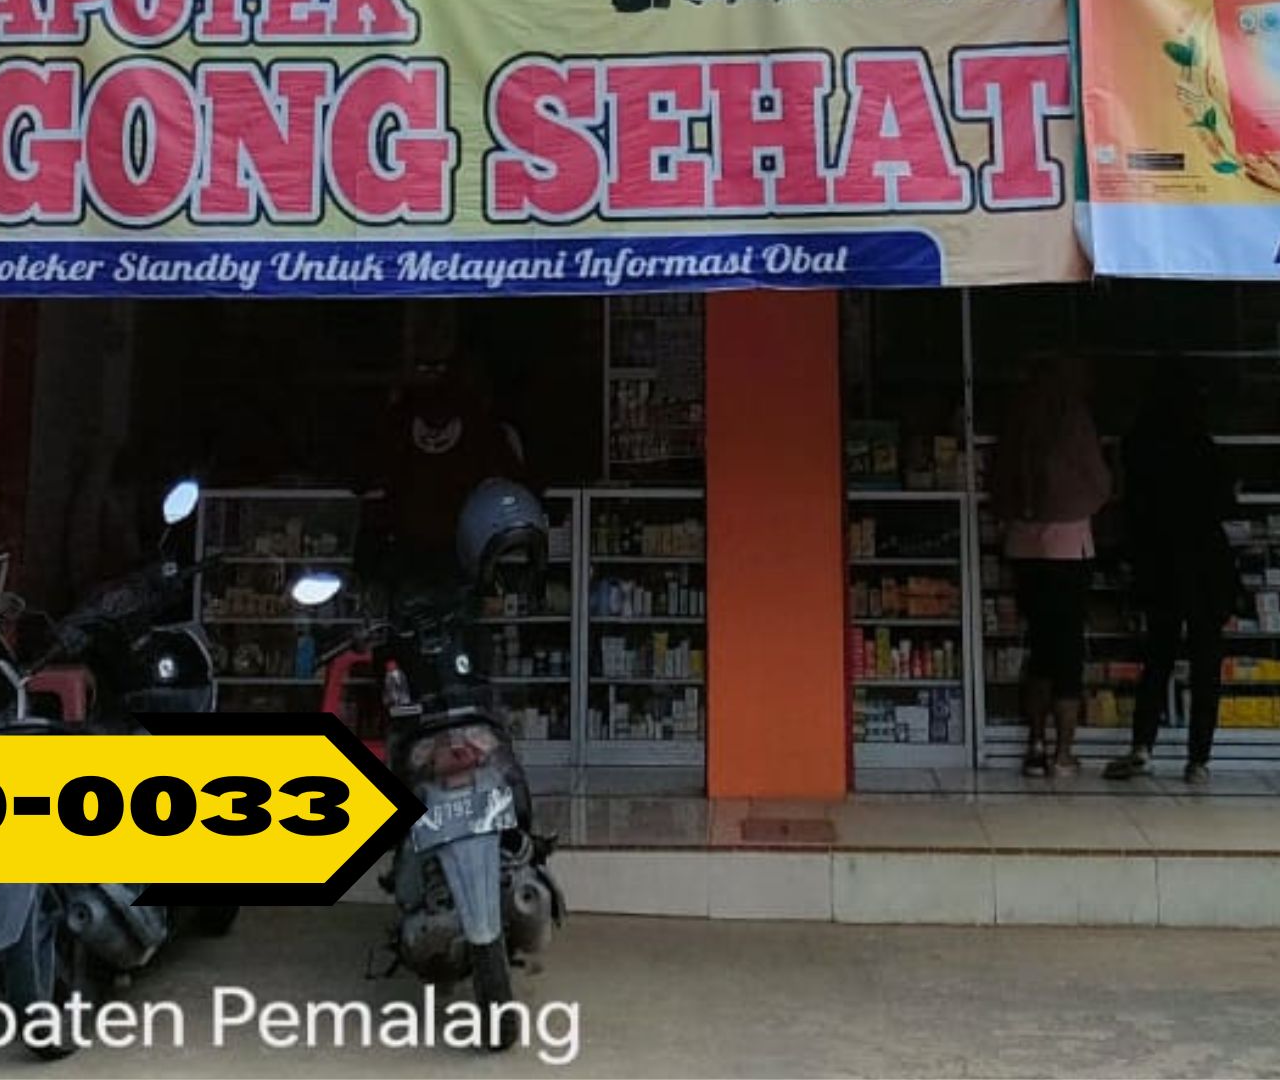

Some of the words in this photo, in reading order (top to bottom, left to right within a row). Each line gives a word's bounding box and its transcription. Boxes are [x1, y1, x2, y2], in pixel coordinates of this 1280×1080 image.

[486, 47, 1070, 219] SEHAT
[114, 251, 262, 291] Standby
[270, 251, 385, 282] Untuk
[397, 249, 566, 289] Melayani
[575, 246, 754, 287] Informasi
[762, 242, 849, 275] Obat
